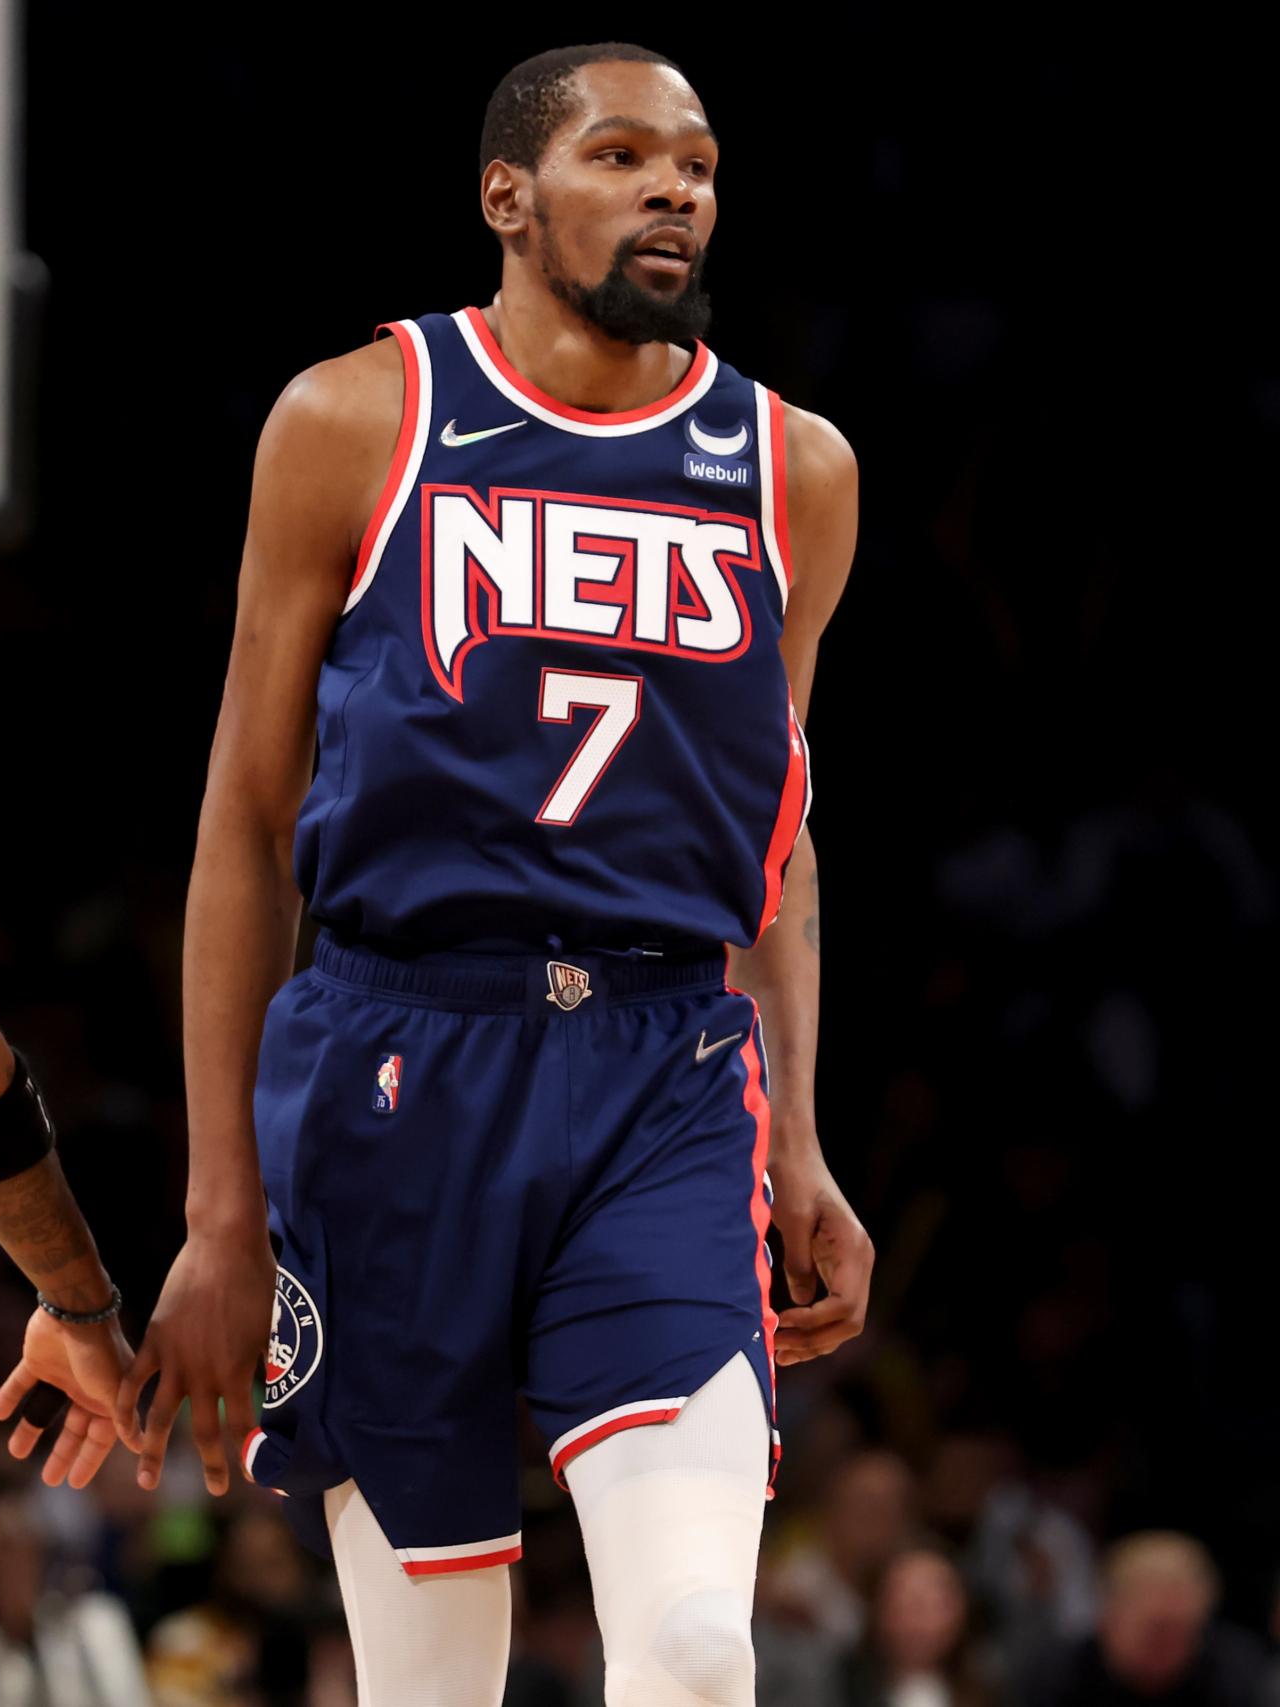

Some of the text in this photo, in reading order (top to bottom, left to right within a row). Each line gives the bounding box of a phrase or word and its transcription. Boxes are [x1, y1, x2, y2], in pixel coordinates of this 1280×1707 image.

[689, 460, 747, 484] Webull
[421, 484, 761, 704] NETS
[535, 667, 643, 826] 7
[555, 966, 586, 991] NETS
[275, 1272, 314, 1328] KLYN
